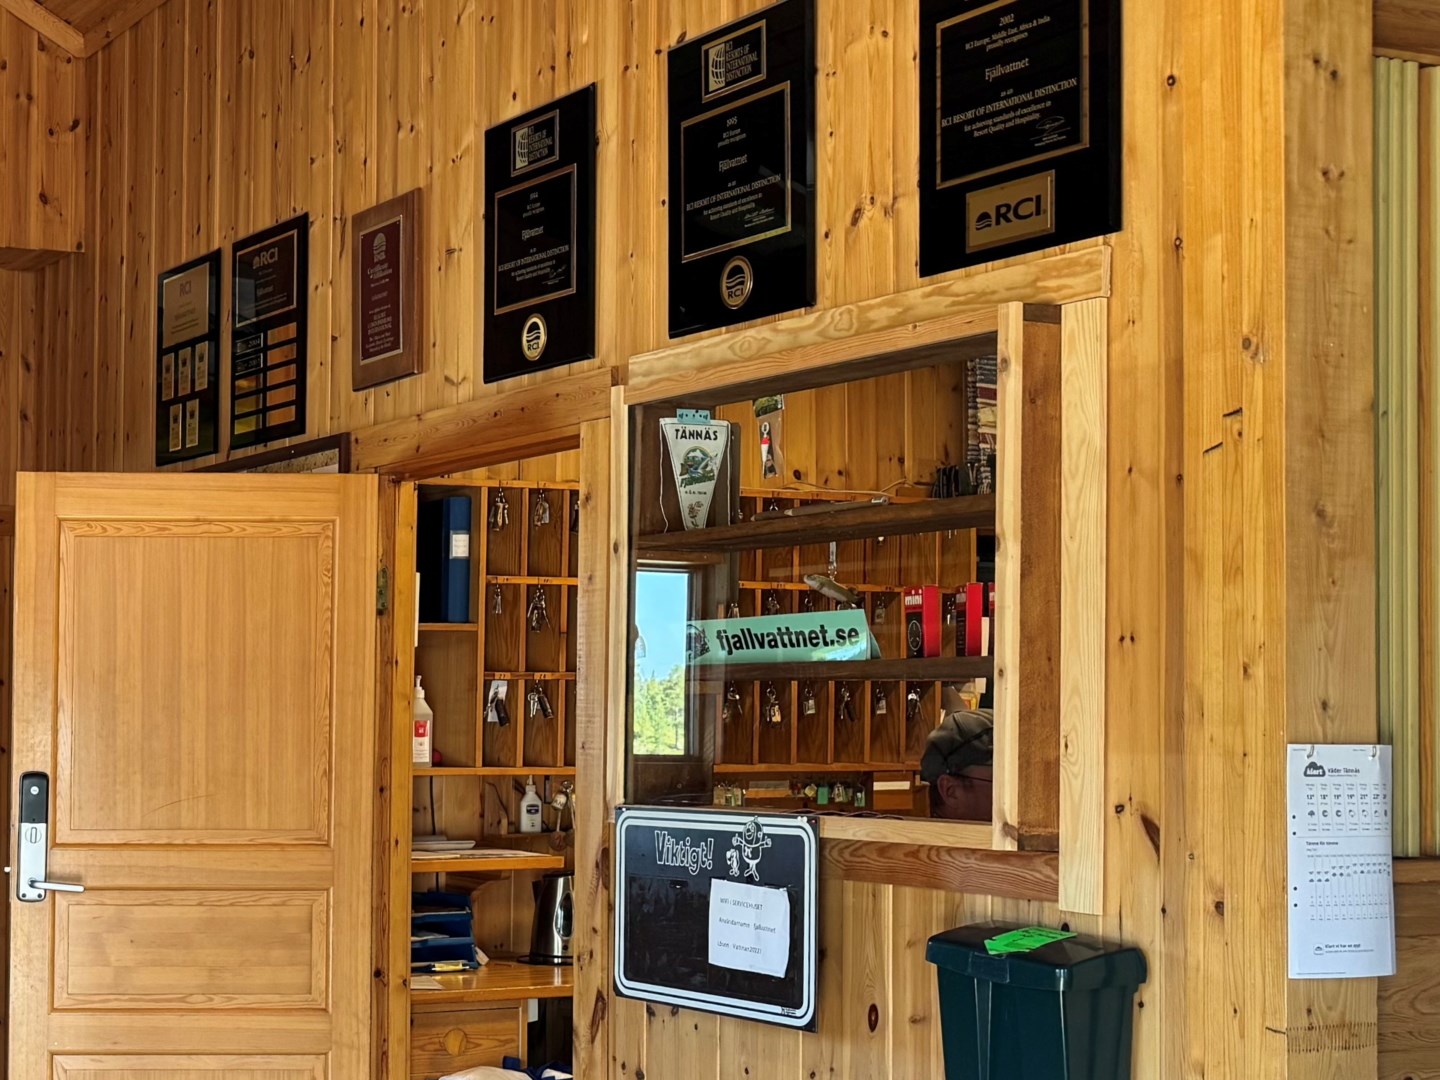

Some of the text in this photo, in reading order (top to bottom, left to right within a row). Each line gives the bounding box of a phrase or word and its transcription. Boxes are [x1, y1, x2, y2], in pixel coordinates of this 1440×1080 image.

[941, 77, 1078, 128] RCI RESORT OF INTERNATIONAL DISTINCTION
[995, 193, 1042, 227] RCI
[260, 247, 279, 268] RCI
[727, 287, 744, 300] RCI
[527, 341, 540, 352] RCI
[675, 426, 718, 441] TÄNNÄS
[905, 588, 922, 606] mini
[716, 624, 860, 656] fjallvattnet.se
[654, 830, 714, 876] Viktigt!
